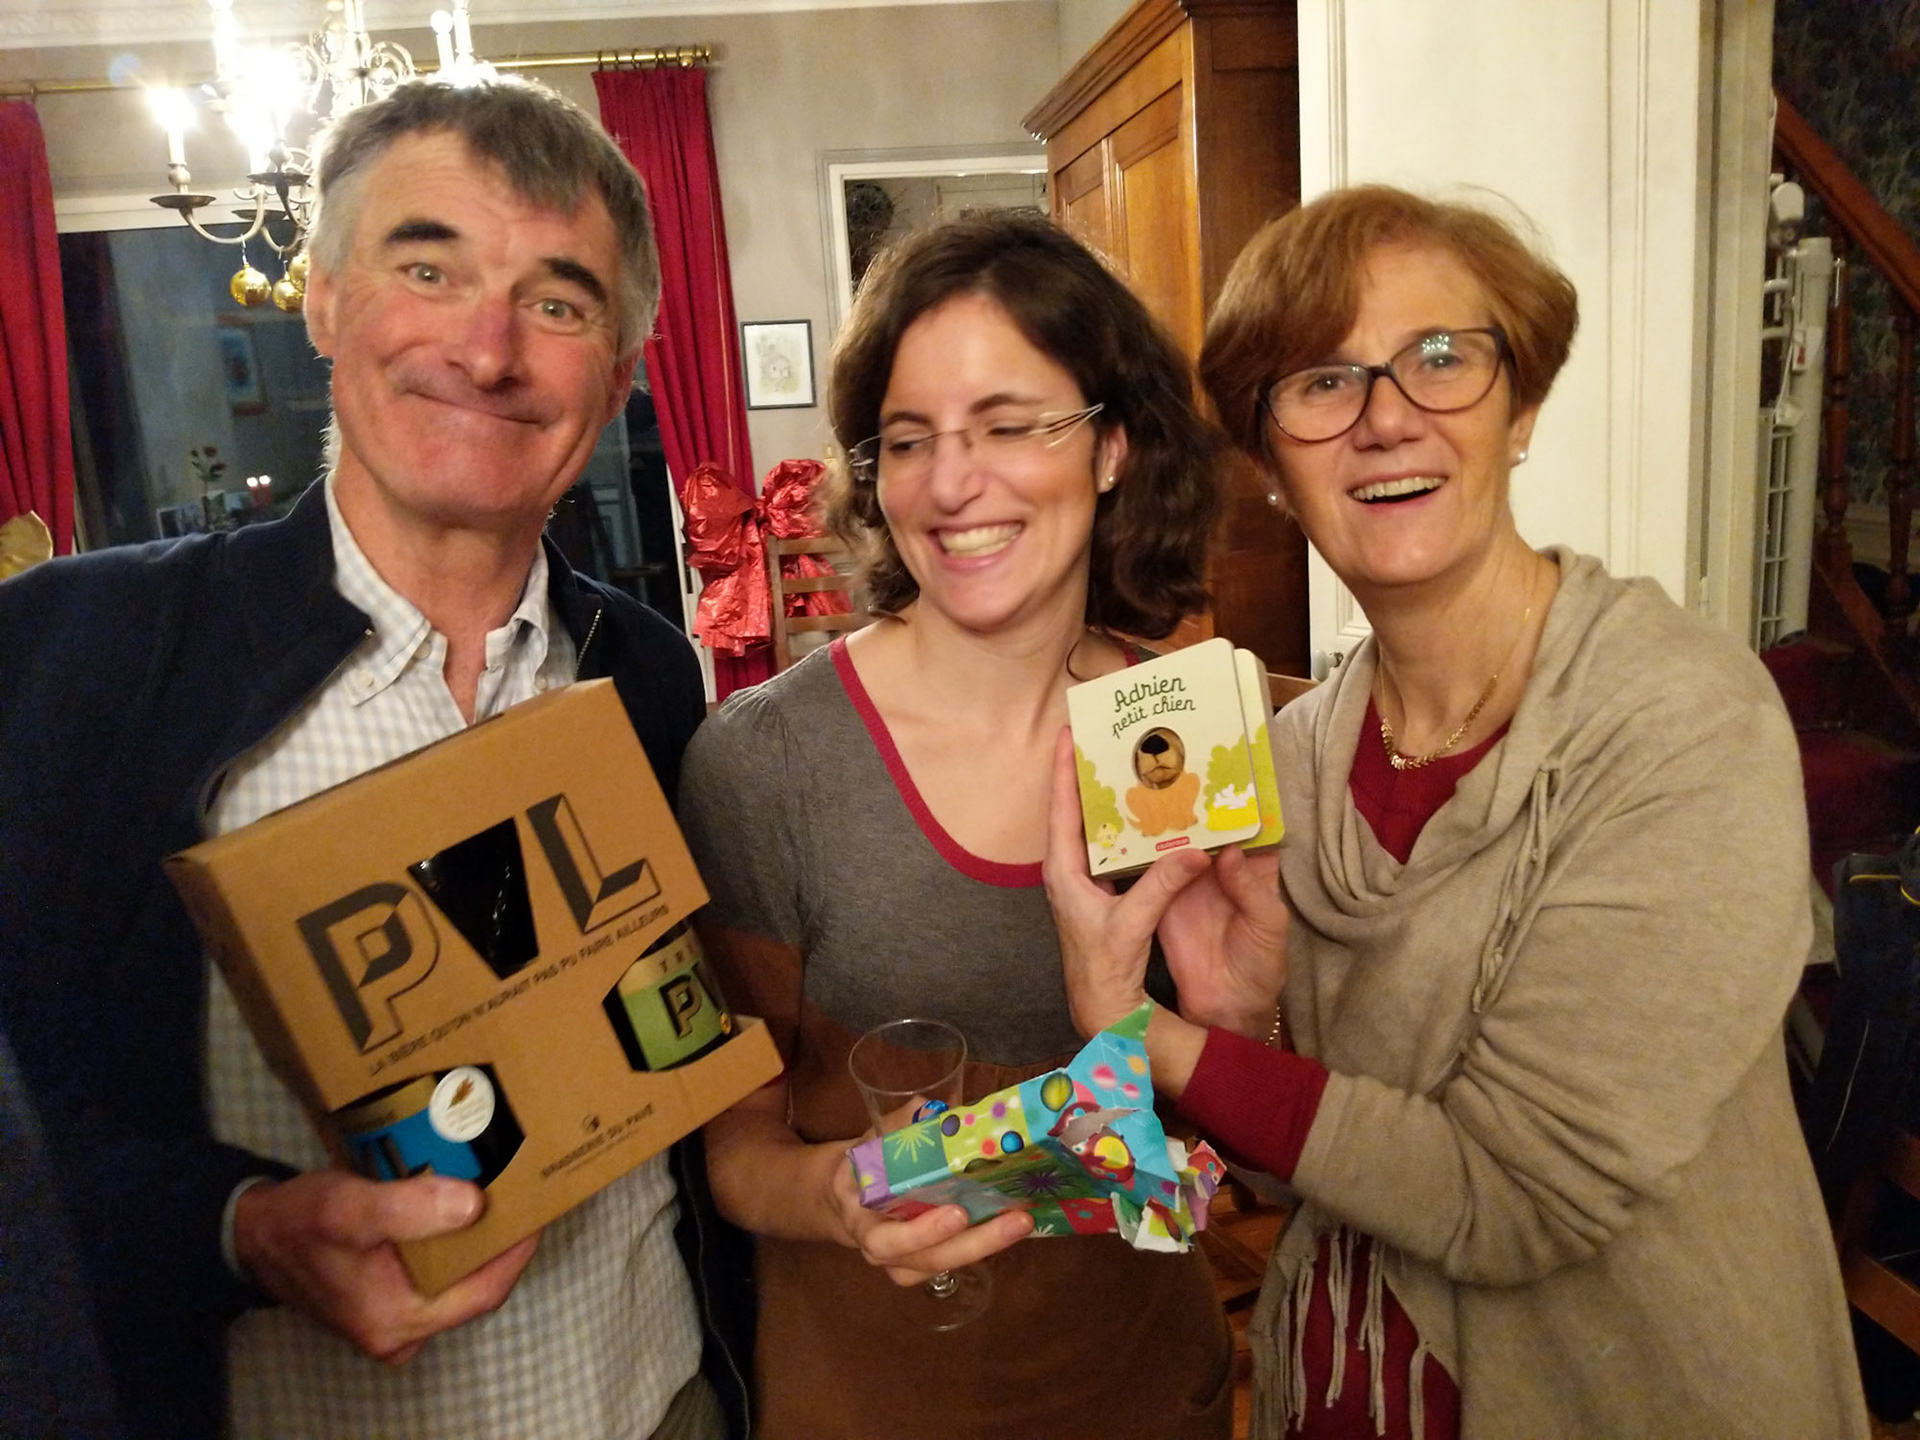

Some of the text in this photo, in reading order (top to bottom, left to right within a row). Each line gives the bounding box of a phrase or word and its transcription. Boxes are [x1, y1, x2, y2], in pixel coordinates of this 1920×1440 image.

[1112, 696, 1196, 739] petit chien
[1114, 676, 1186, 713] Adrien
[296, 793, 661, 1056] PVL
[533, 964, 559, 985] PAS
[578, 933, 614, 960] FAIRE
[615, 903, 670, 941] AILLEURS
